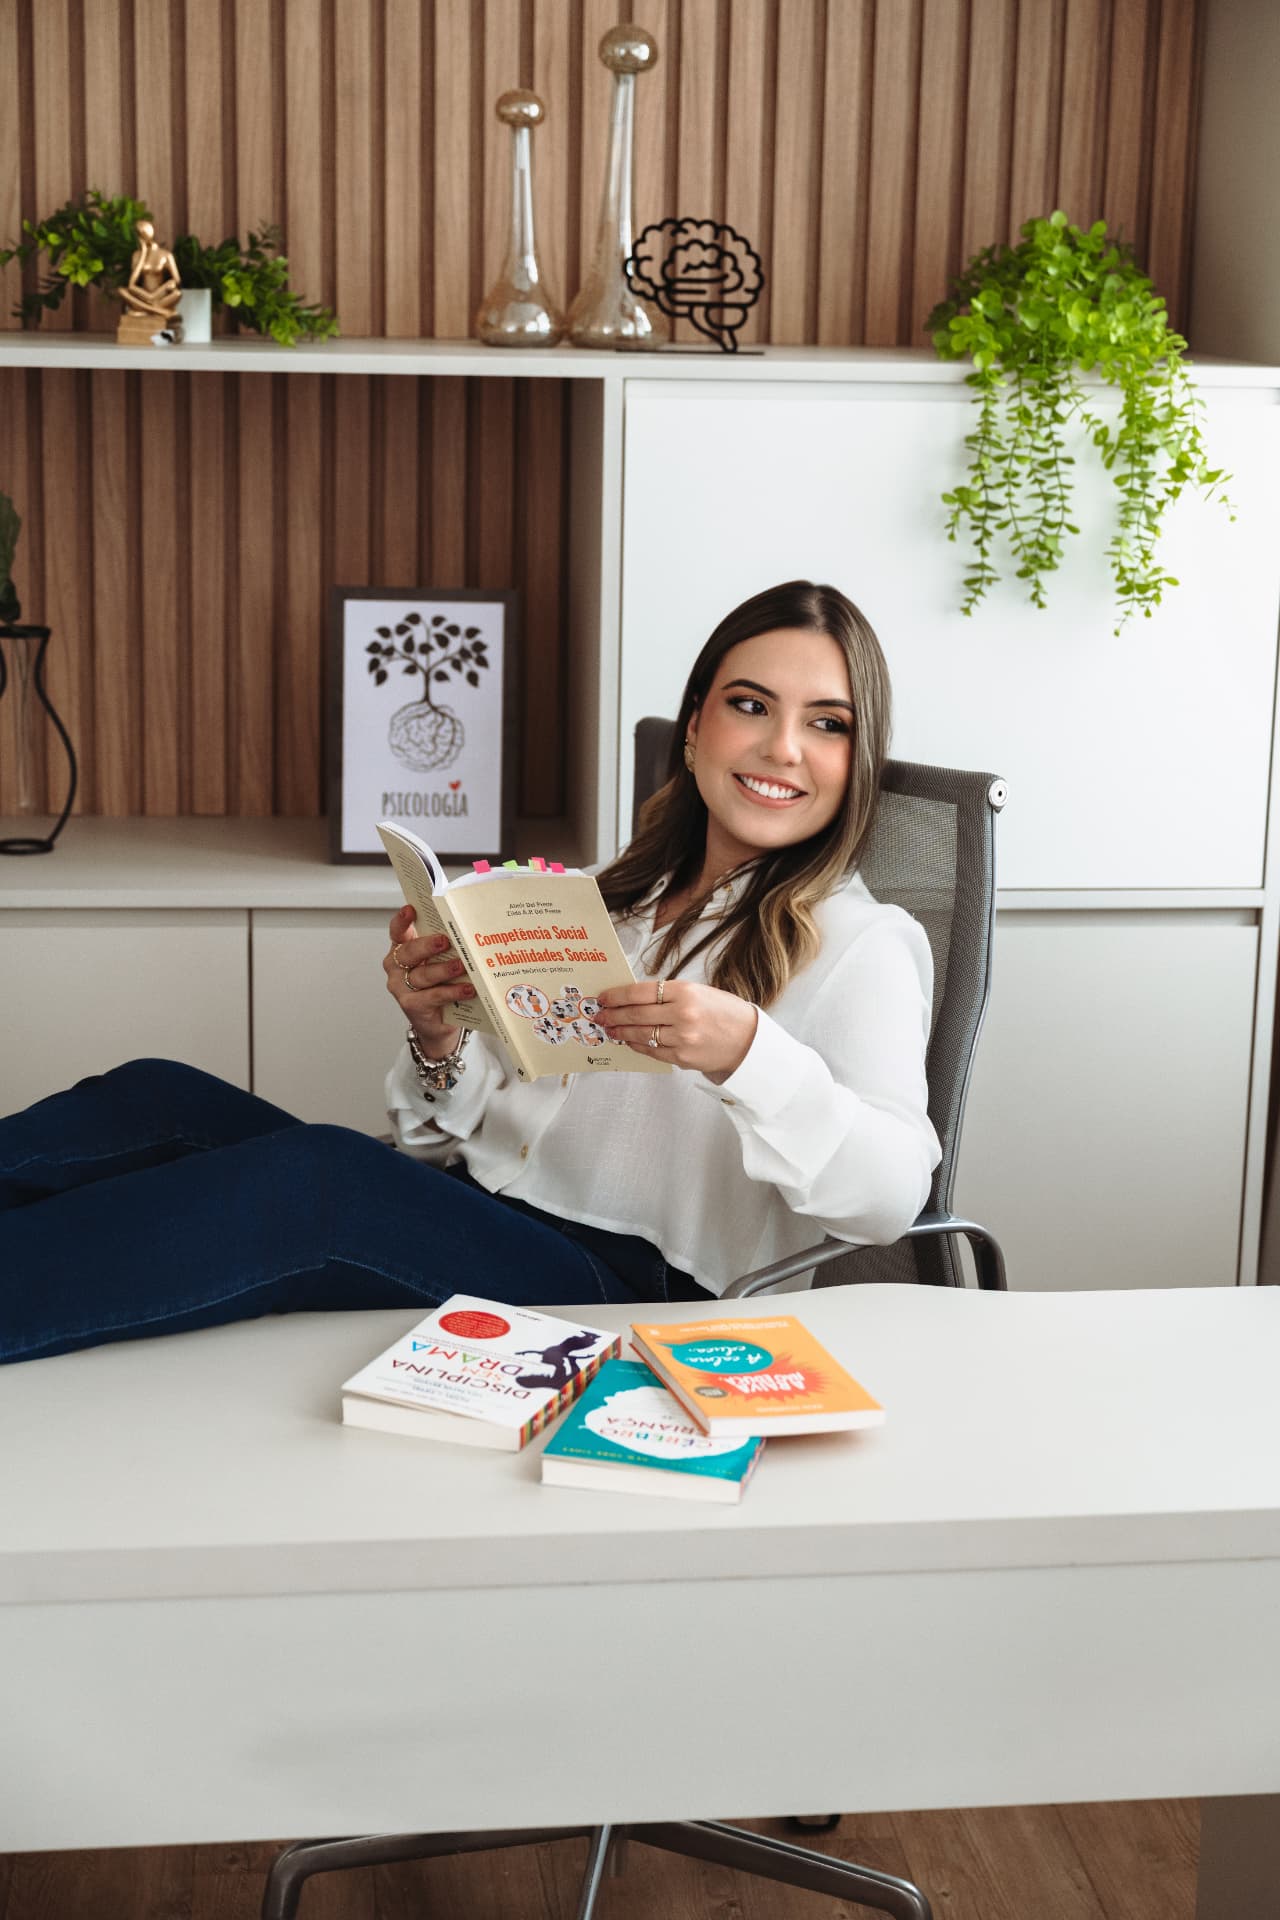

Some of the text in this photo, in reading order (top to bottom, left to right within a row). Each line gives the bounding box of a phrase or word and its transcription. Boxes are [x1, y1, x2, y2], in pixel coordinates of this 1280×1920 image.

[381, 791, 468, 817] PSICOLOGIA
[474, 925, 589, 947] Competência Social
[486, 947, 608, 968] e Habilidades Sociais
[493, 968, 521, 979] Manual
[411, 1341, 524, 1377] DRAMA
[392, 1359, 532, 1400] DISCIPLINA
[461, 1366, 503, 1381] SEM
[606, 1416, 696, 1435] RIANÇA
